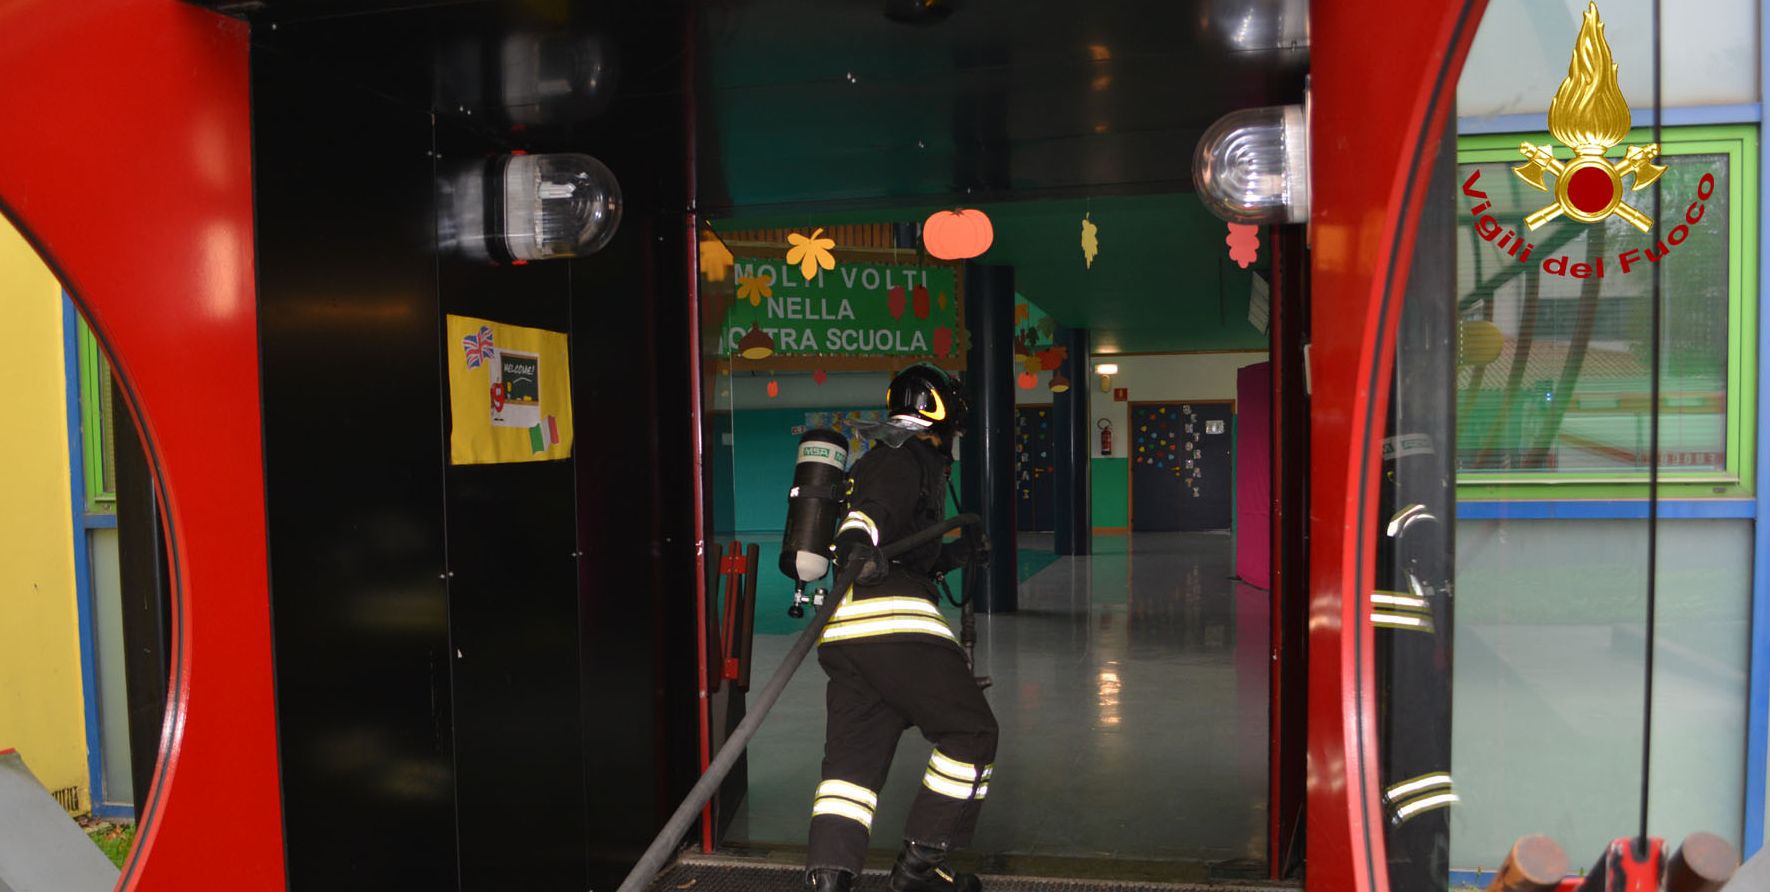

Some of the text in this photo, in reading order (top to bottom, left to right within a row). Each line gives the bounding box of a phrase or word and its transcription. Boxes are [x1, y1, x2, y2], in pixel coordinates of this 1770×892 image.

[841, 267, 927, 291] VOLTI
[767, 297, 856, 321] NELLA
[826, 328, 929, 352] SCUOLA
[504, 364, 535, 375] WELCOME!
[803, 447, 830, 458] MSA
